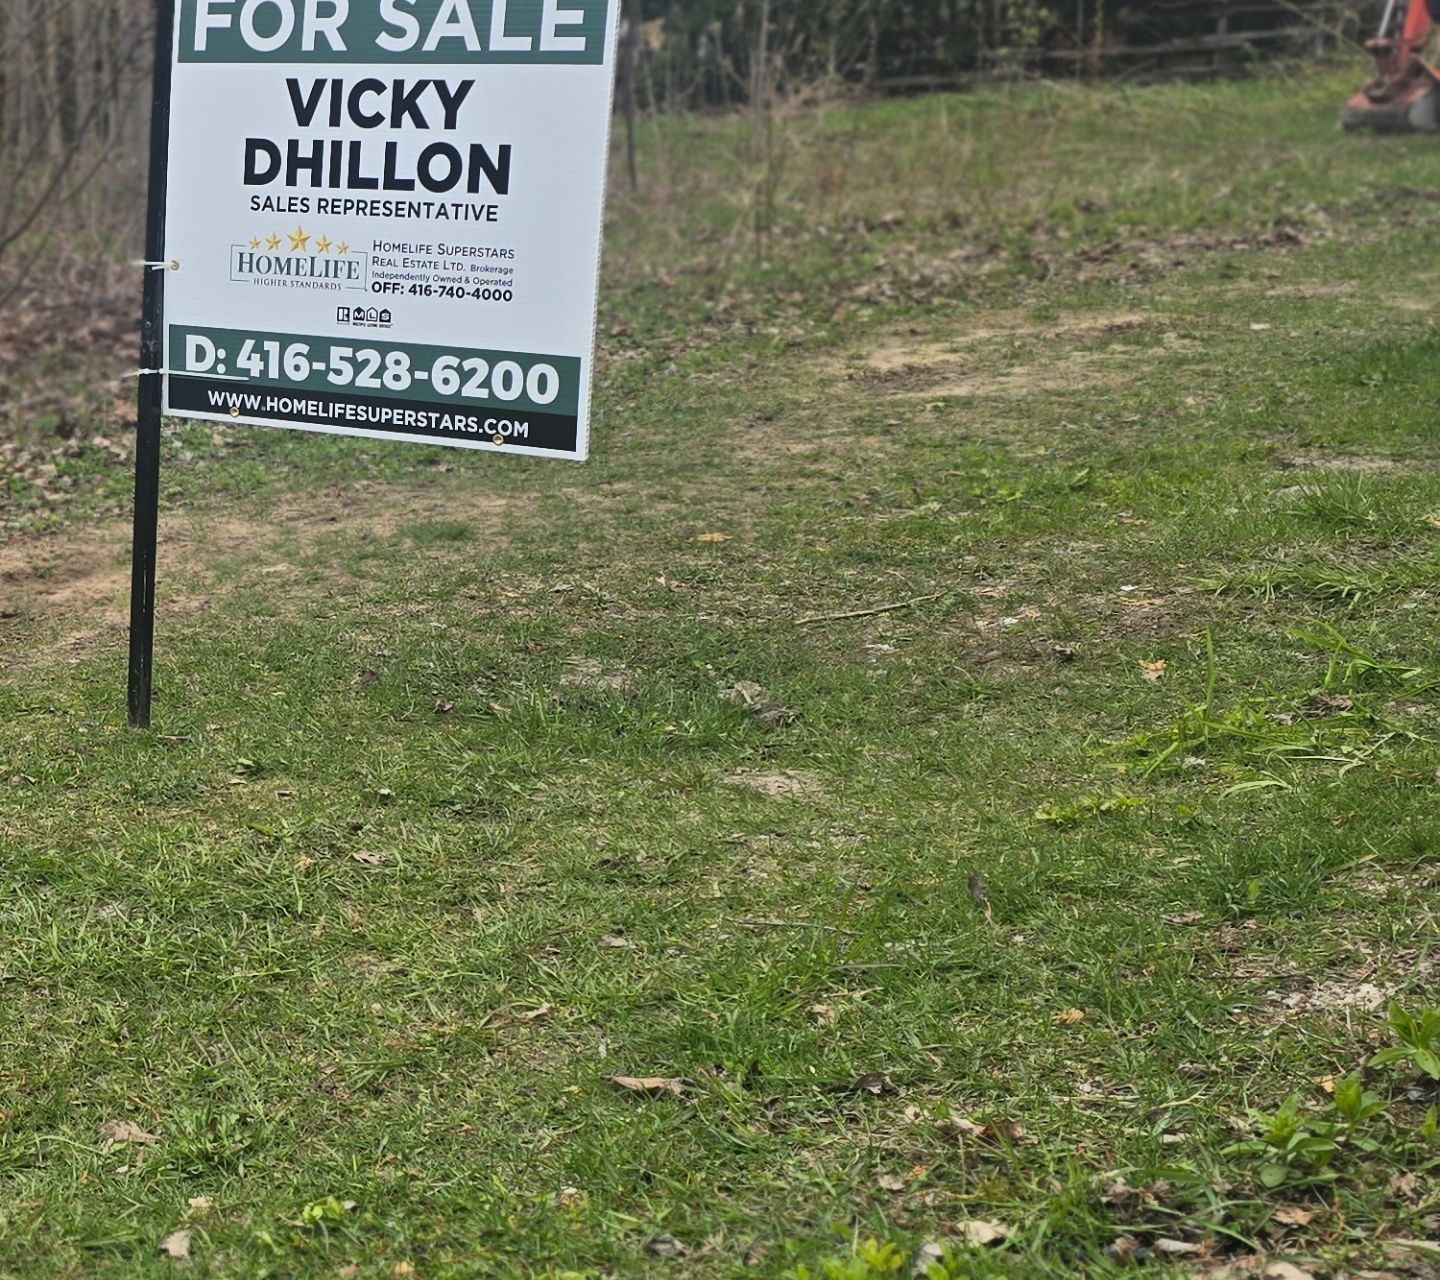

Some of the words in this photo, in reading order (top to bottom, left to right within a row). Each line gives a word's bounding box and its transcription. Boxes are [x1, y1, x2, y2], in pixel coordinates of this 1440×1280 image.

[285, 77, 476, 130] VICKY
[243, 137, 512, 195] DHILLON
[249, 195, 310, 214] SALES
[316, 197, 499, 222] REPRESENTATIVE
[372, 239, 433, 255] HOMELIFE
[437, 243, 515, 259] SUPERSTARS
[372, 256, 399, 268] REAL
[402, 257, 440, 270] ESTATE
[470, 264, 514, 275] Brokerage
[253, 277, 288, 288] HIGHER
[290, 280, 342, 291] STANDARDS
[371, 270, 430, 283] Independently
[432, 274, 463, 284] Owned
[464, 276, 470, 284] &
[472, 276, 513, 287] Operated
[371, 281, 404, 295] OFF:
[408, 284, 513, 302] 416-740-4000
[185, 333, 227, 375] D:
[236, 337, 560, 405] 416-528-6200
[207, 390, 529, 439] WWW.HOMELIFESUPERSTARS.COM
